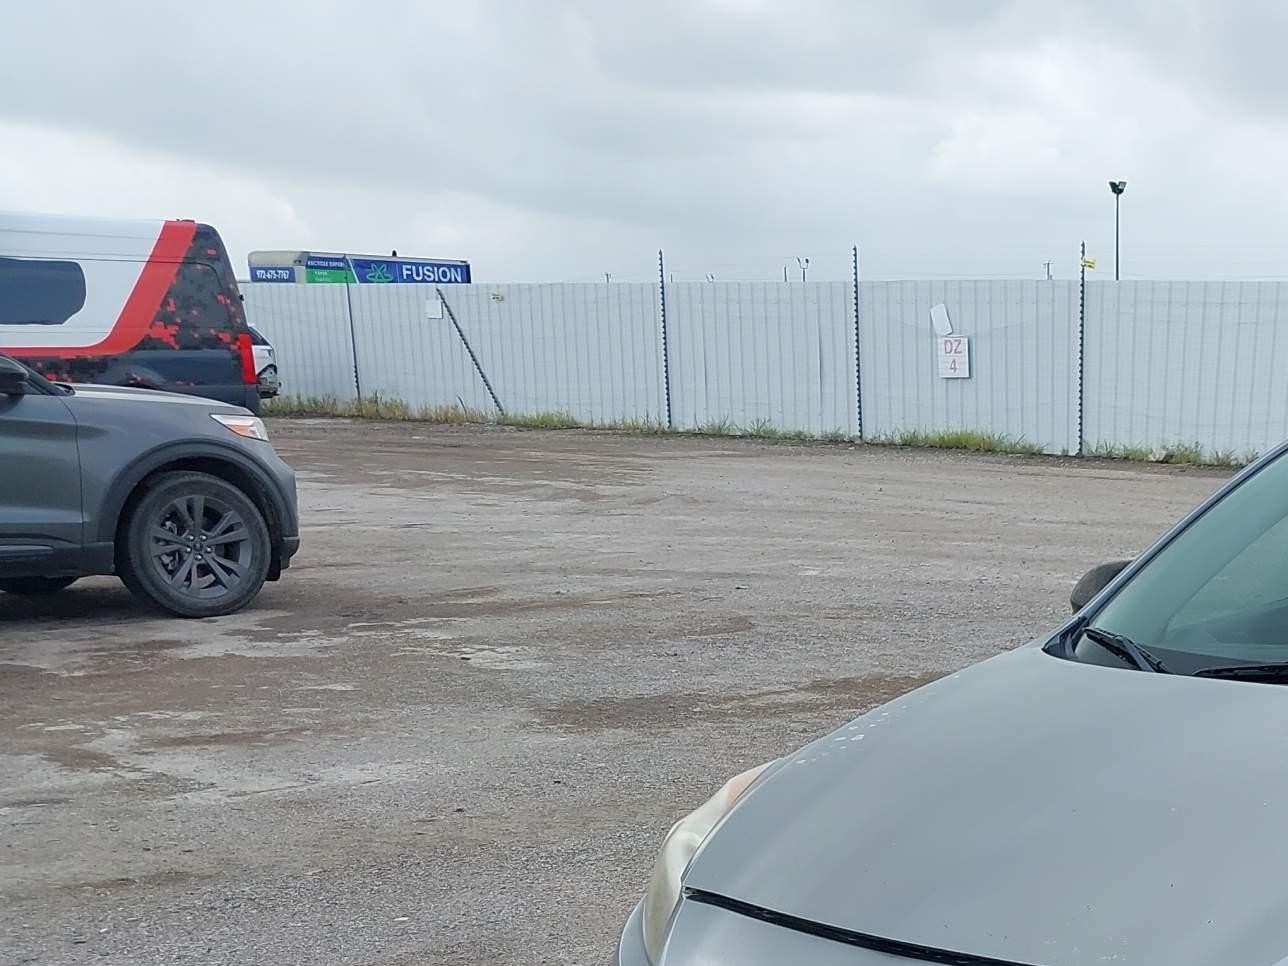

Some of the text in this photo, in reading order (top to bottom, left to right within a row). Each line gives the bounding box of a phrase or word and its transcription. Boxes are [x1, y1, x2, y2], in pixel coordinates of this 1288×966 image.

[402, 264, 462, 283] FUSION
[944, 339, 962, 354] DZ
[949, 358, 958, 373] 4
